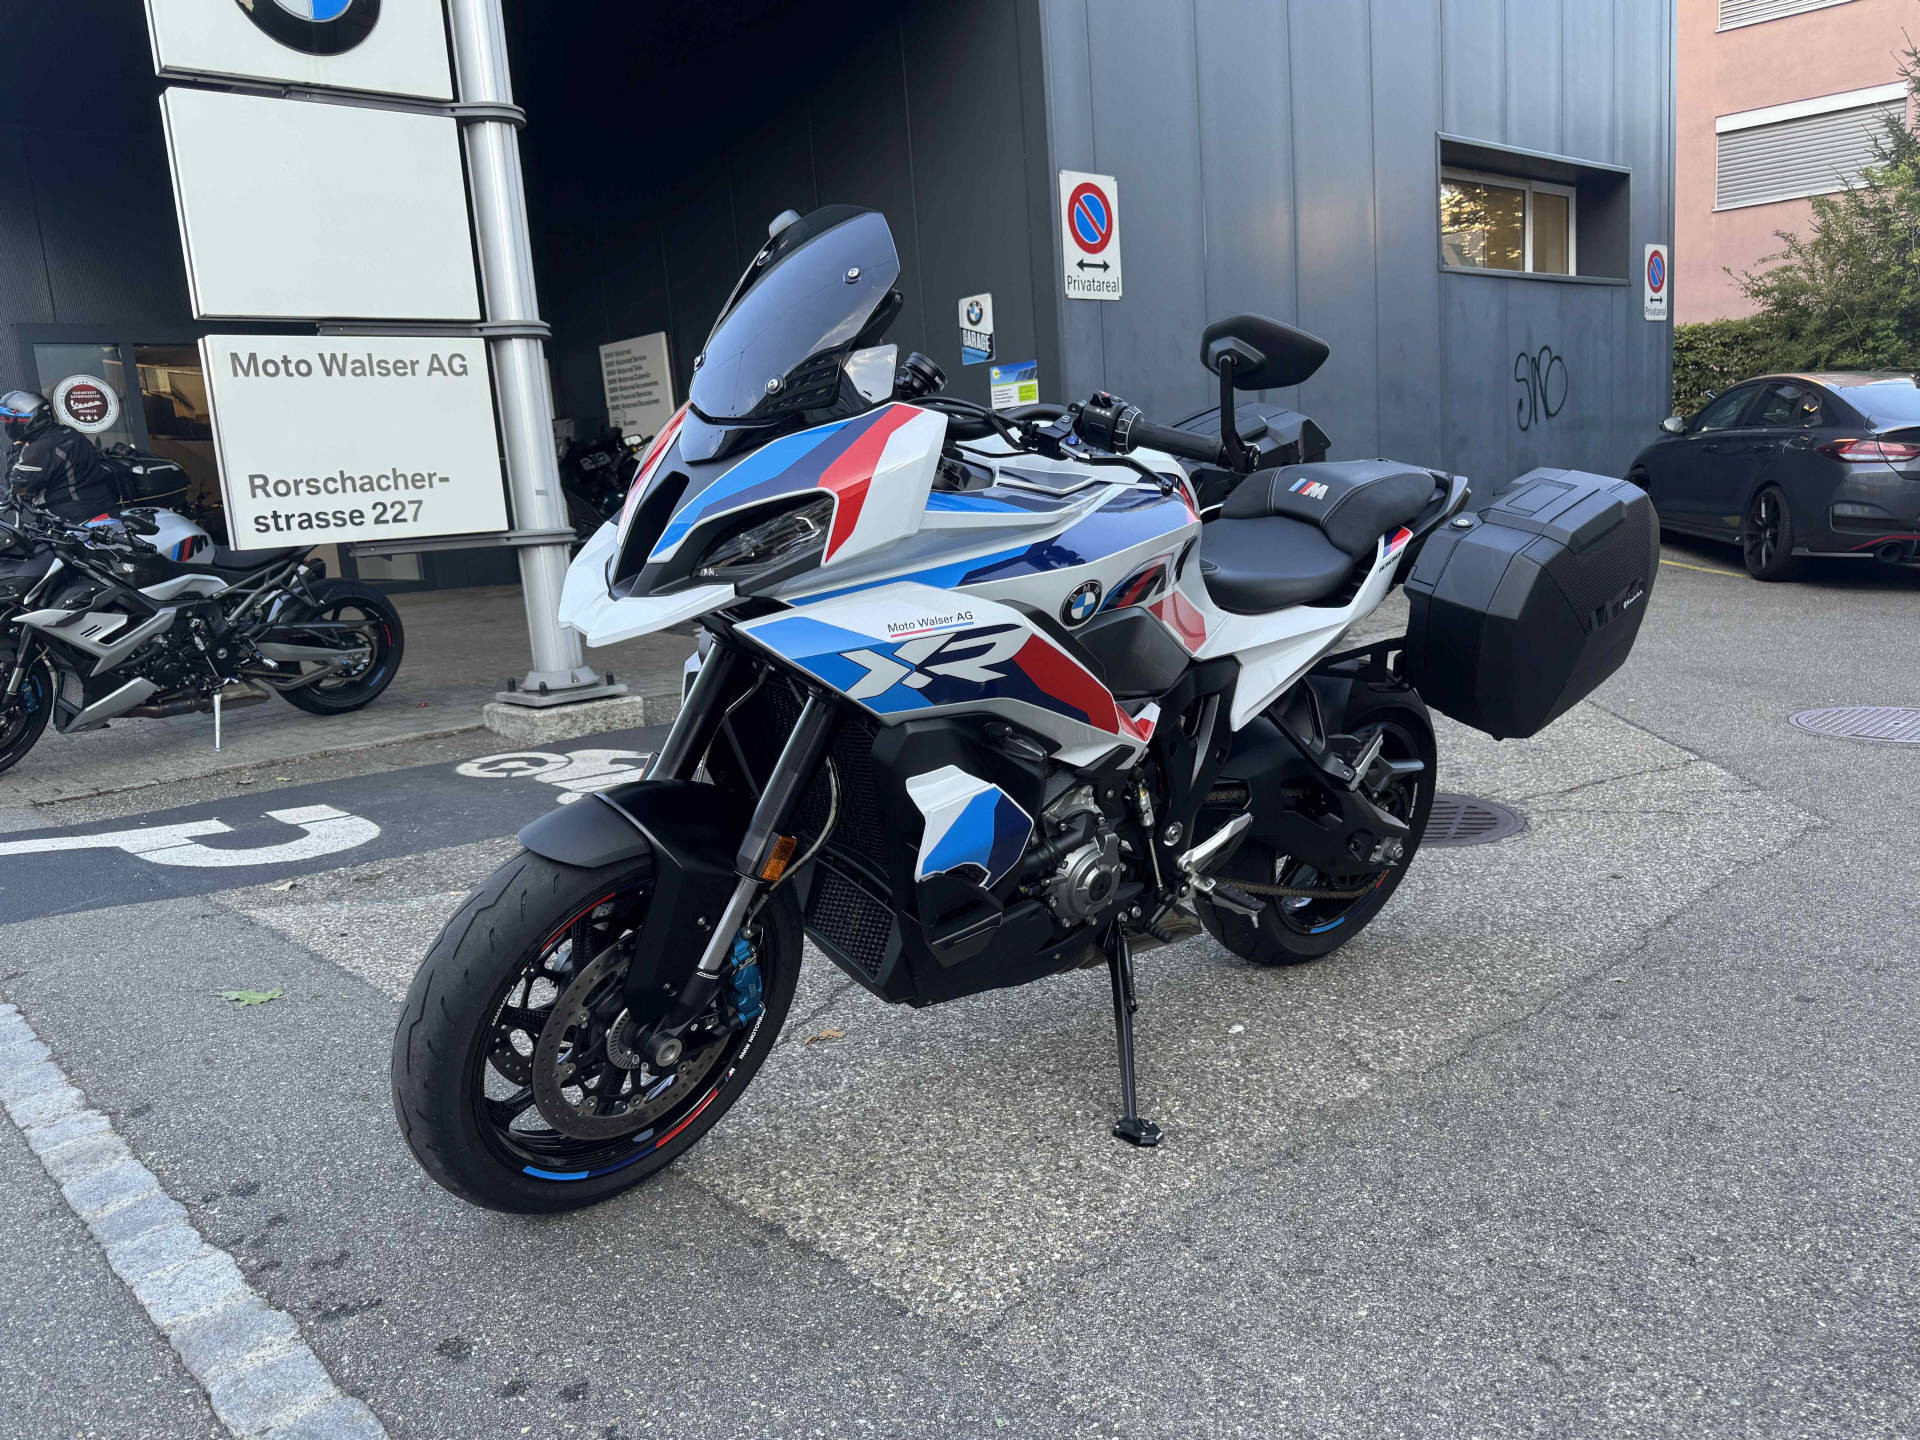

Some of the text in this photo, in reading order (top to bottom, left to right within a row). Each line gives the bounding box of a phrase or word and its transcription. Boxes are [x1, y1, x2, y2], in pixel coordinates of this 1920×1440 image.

[1067, 275, 1120, 293] Privatareal
[962, 329, 991, 352] GARAGE
[229, 351, 469, 379] Moto Walser AG
[247, 467, 450, 500] Rorschacher-
[253, 499, 424, 534] strasse 227
[1069, 583, 1101, 602] BMW
[887, 611, 973, 633] Moto Walser AG
